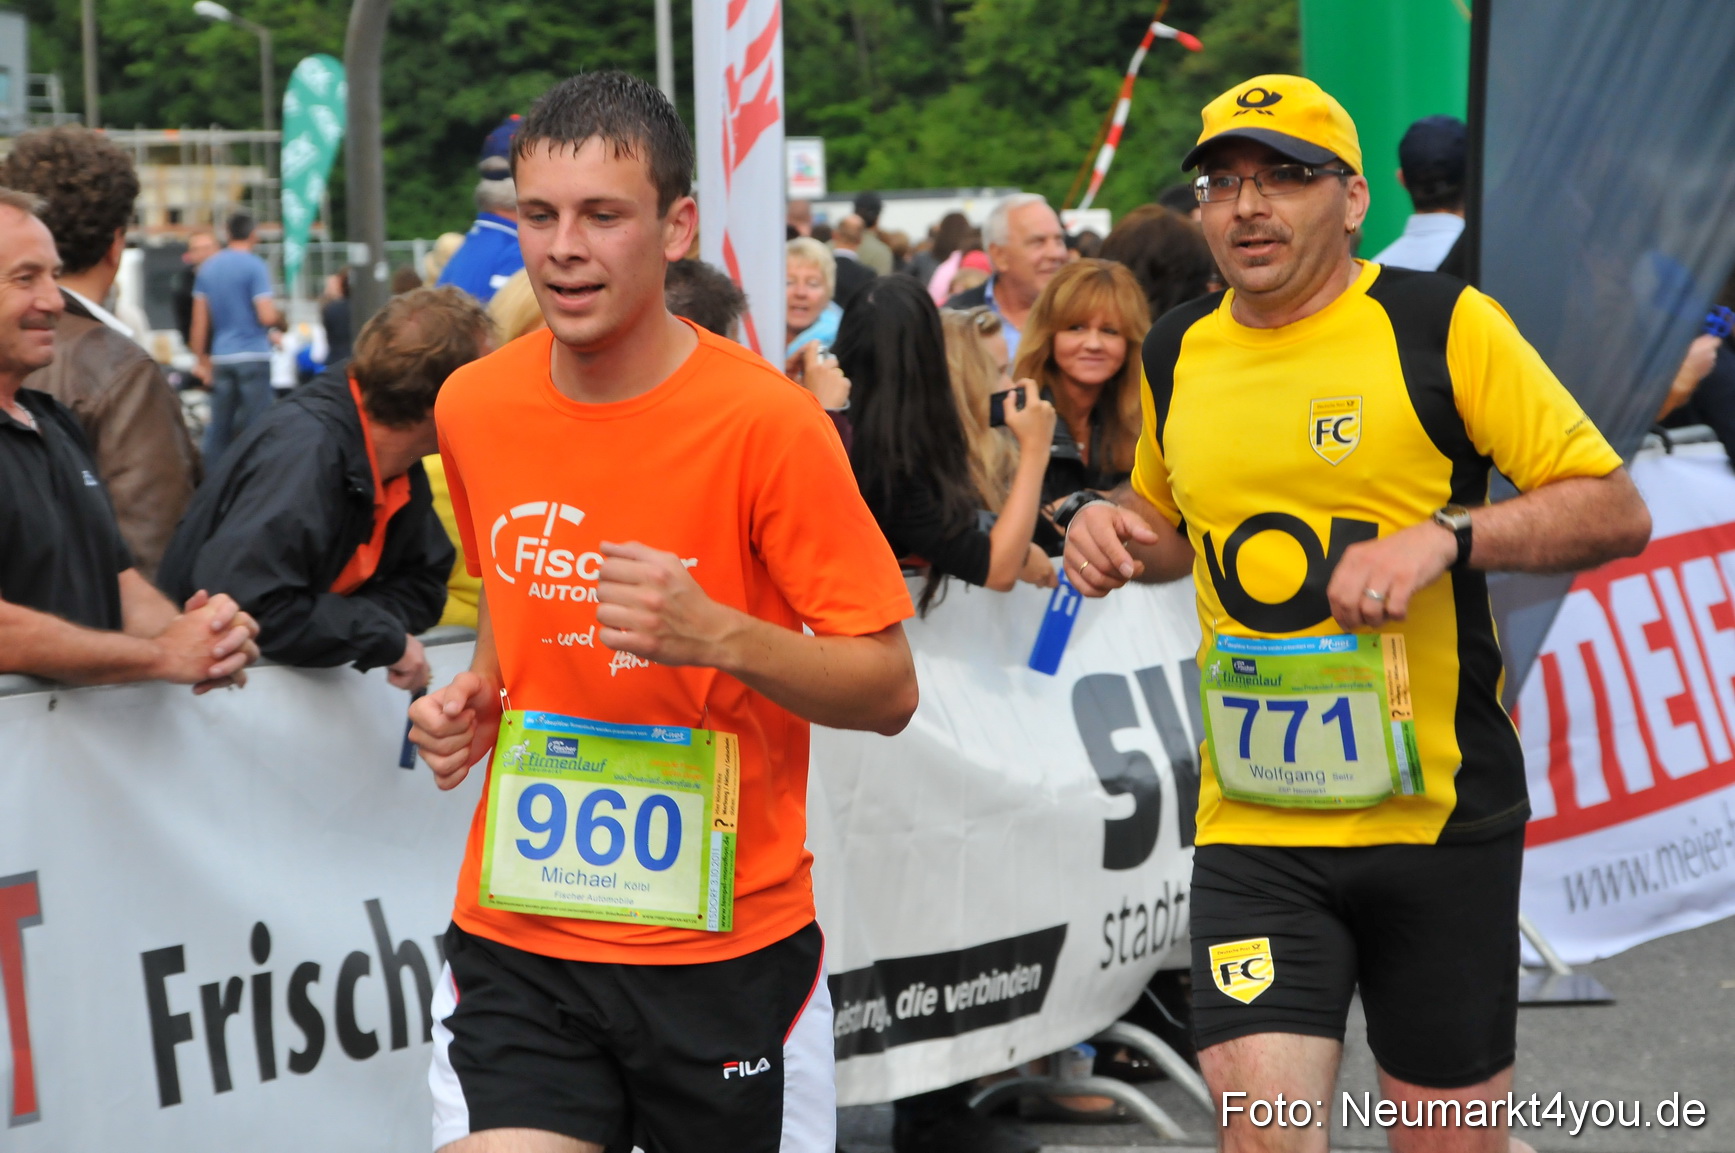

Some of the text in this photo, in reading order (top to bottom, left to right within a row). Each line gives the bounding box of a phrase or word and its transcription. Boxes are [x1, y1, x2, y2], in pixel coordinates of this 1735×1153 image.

[1316, 416, 1354, 446] FC
[1223, 671, 1283, 687] firmenlauf
[1222, 695, 1359, 764] 771
[529, 752, 608, 773] firmenlauf
[1249, 763, 1326, 785] Wolfgang
[515, 782, 683, 872] 960
[541, 865, 617, 889] Michael
[554, 890, 635, 906] Fischer Automobile
[1220, 957, 1266, 986] FC
[140, 898, 446, 1109] Frisch
[896, 981, 938, 1020] die
[944, 962, 1042, 1013] verbinden
[723, 1057, 771, 1080] FILA
